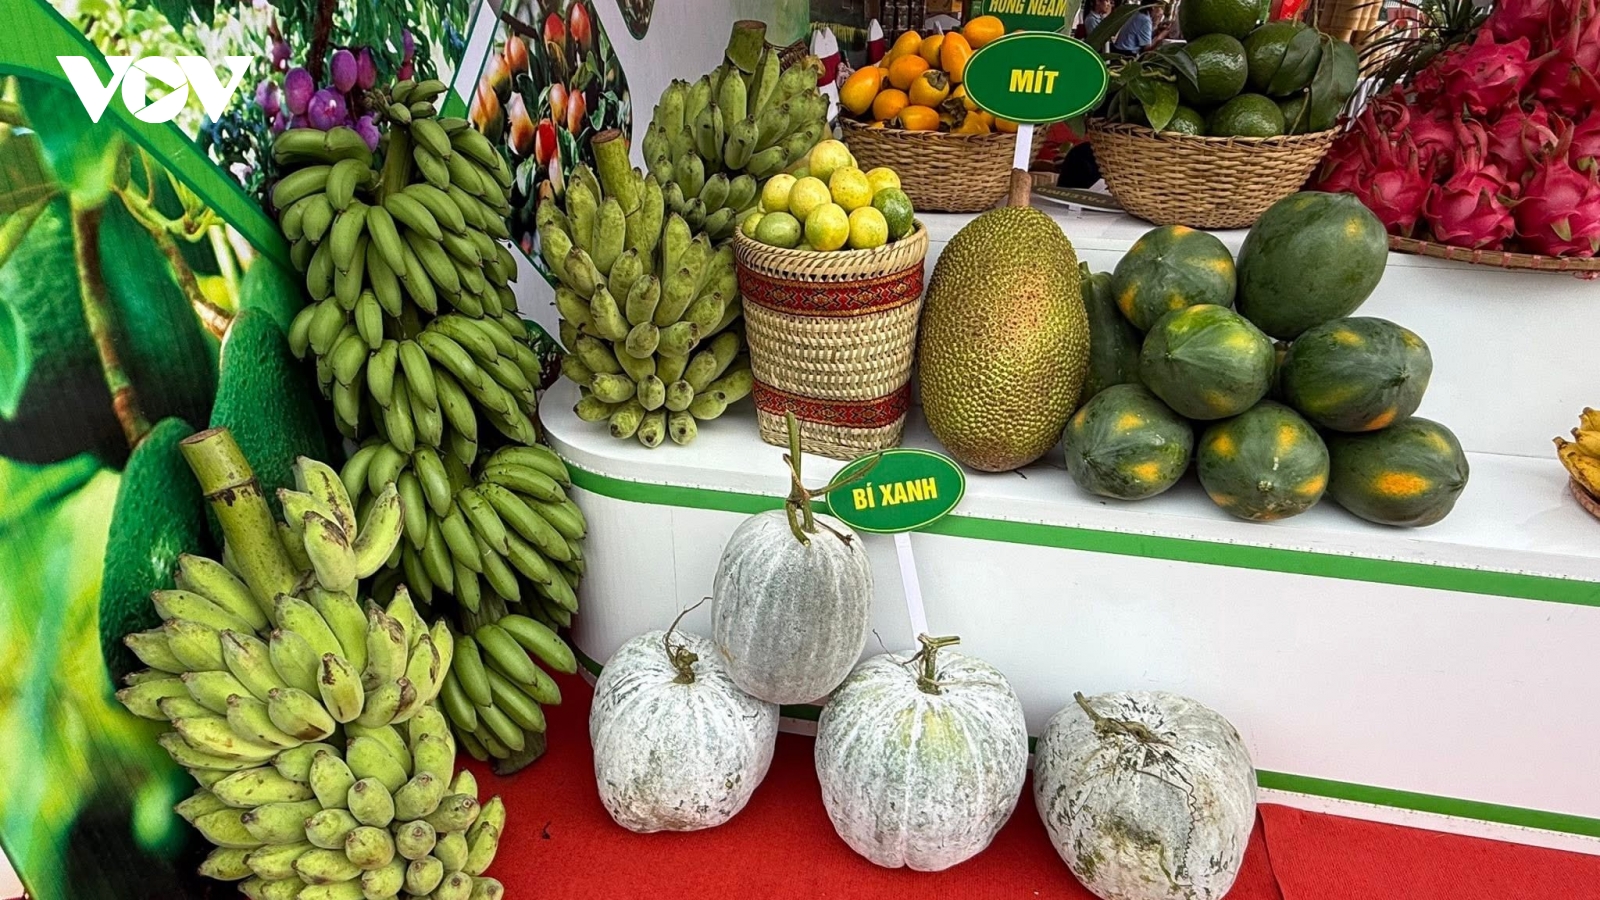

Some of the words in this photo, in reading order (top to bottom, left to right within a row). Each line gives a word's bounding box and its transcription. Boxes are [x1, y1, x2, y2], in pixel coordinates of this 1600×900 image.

[1009, 65, 1059, 94] MÍT
[852, 482, 875, 510] BÍ
[879, 477, 938, 506] XANH
